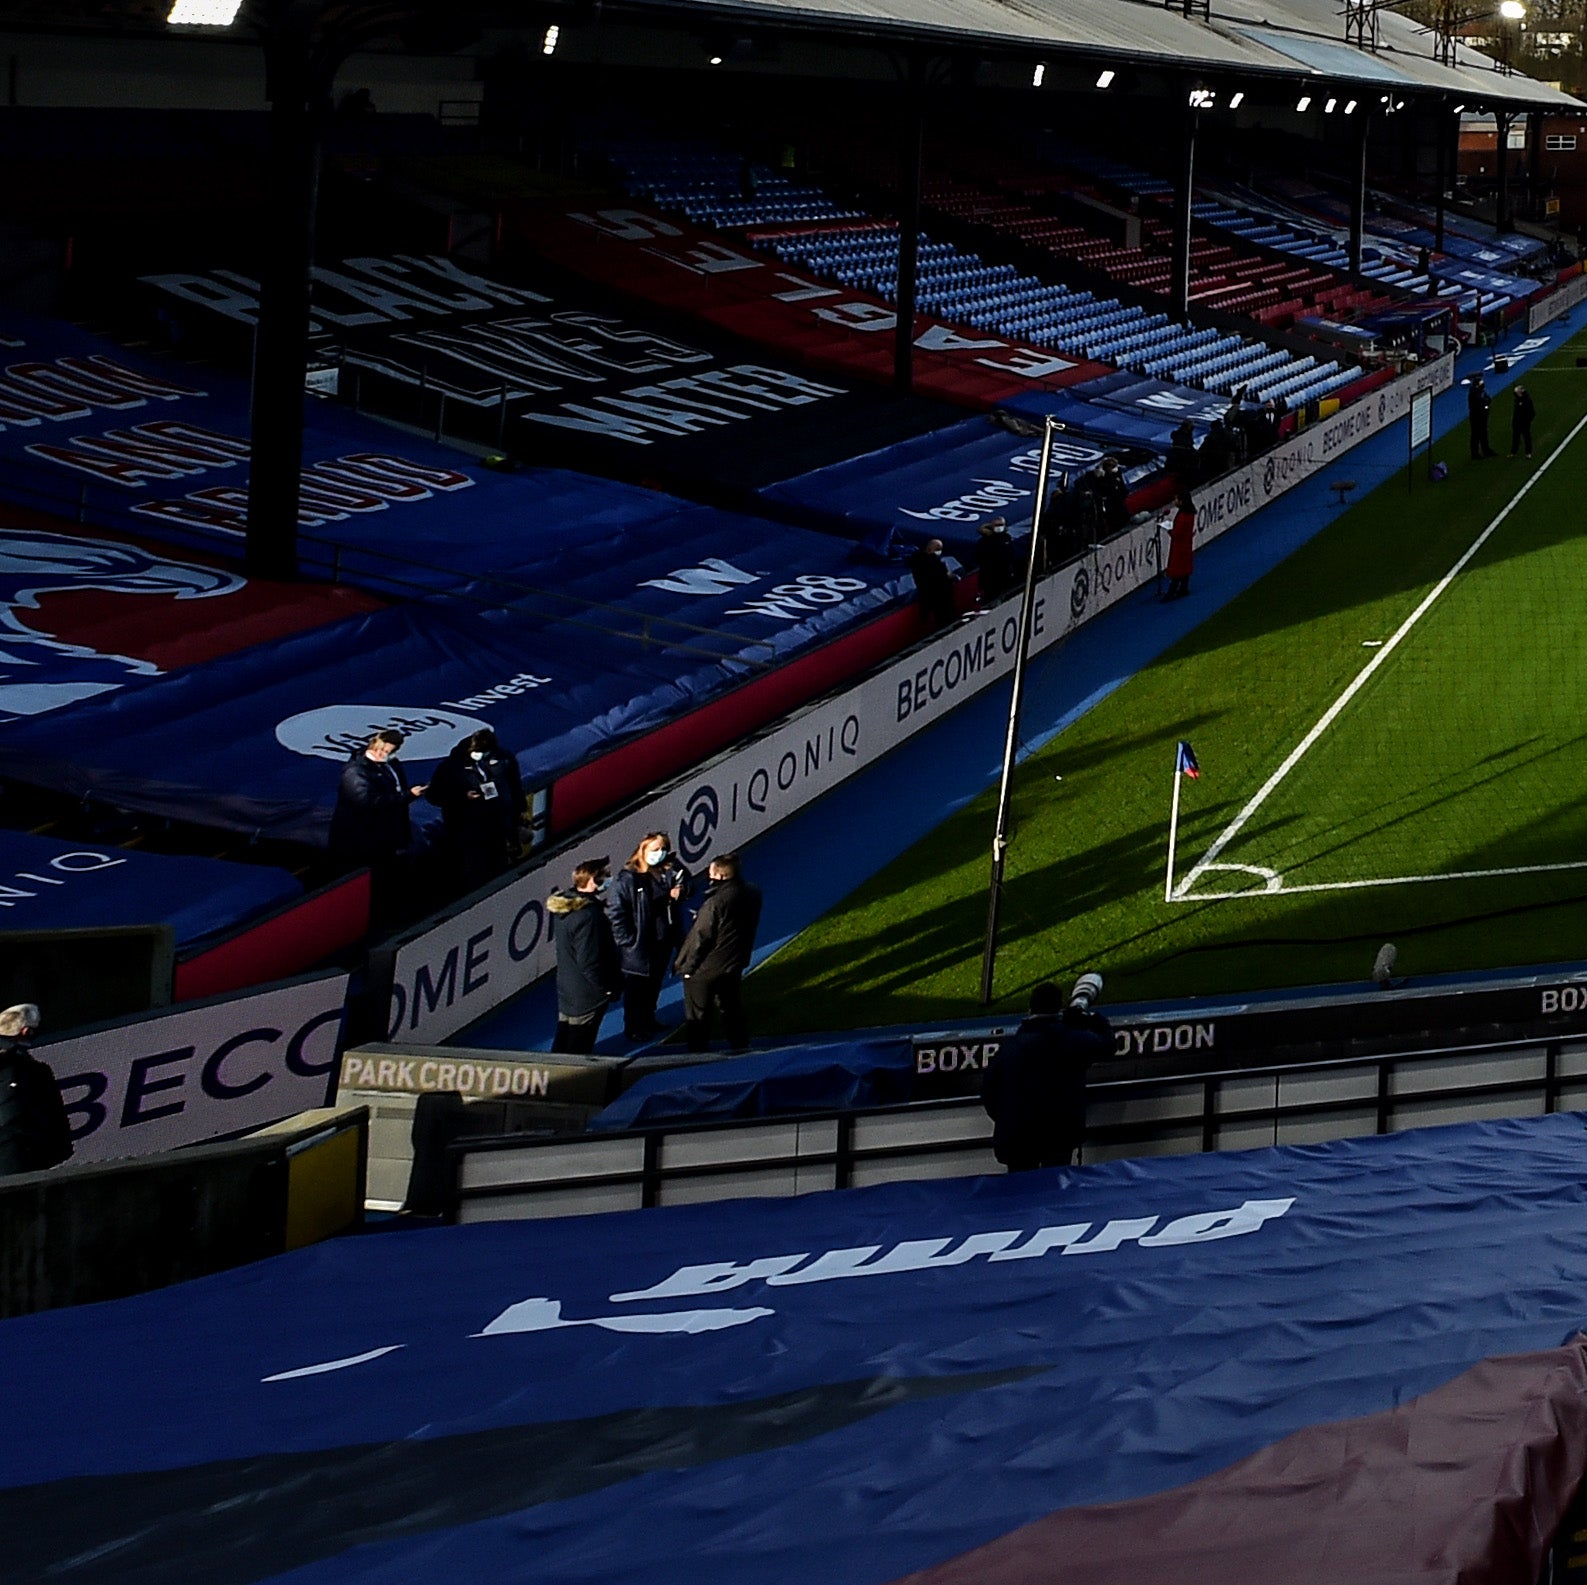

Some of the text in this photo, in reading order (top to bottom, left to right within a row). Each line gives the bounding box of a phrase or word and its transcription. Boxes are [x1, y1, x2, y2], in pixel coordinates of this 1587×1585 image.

[316, 310, 715, 408] LIVES
[521, 363, 850, 446] MATTER
[24, 420, 253, 488] AND
[1322, 419, 1355, 454] BECOME
[1227, 478, 1252, 512] ONE
[724, 574, 869, 620] W88
[440, 672, 553, 712] Invest
[897, 637, 996, 721] BECOME
[731, 714, 860, 822] IQONIQ
[418, 1059, 550, 1098] CROYDON
